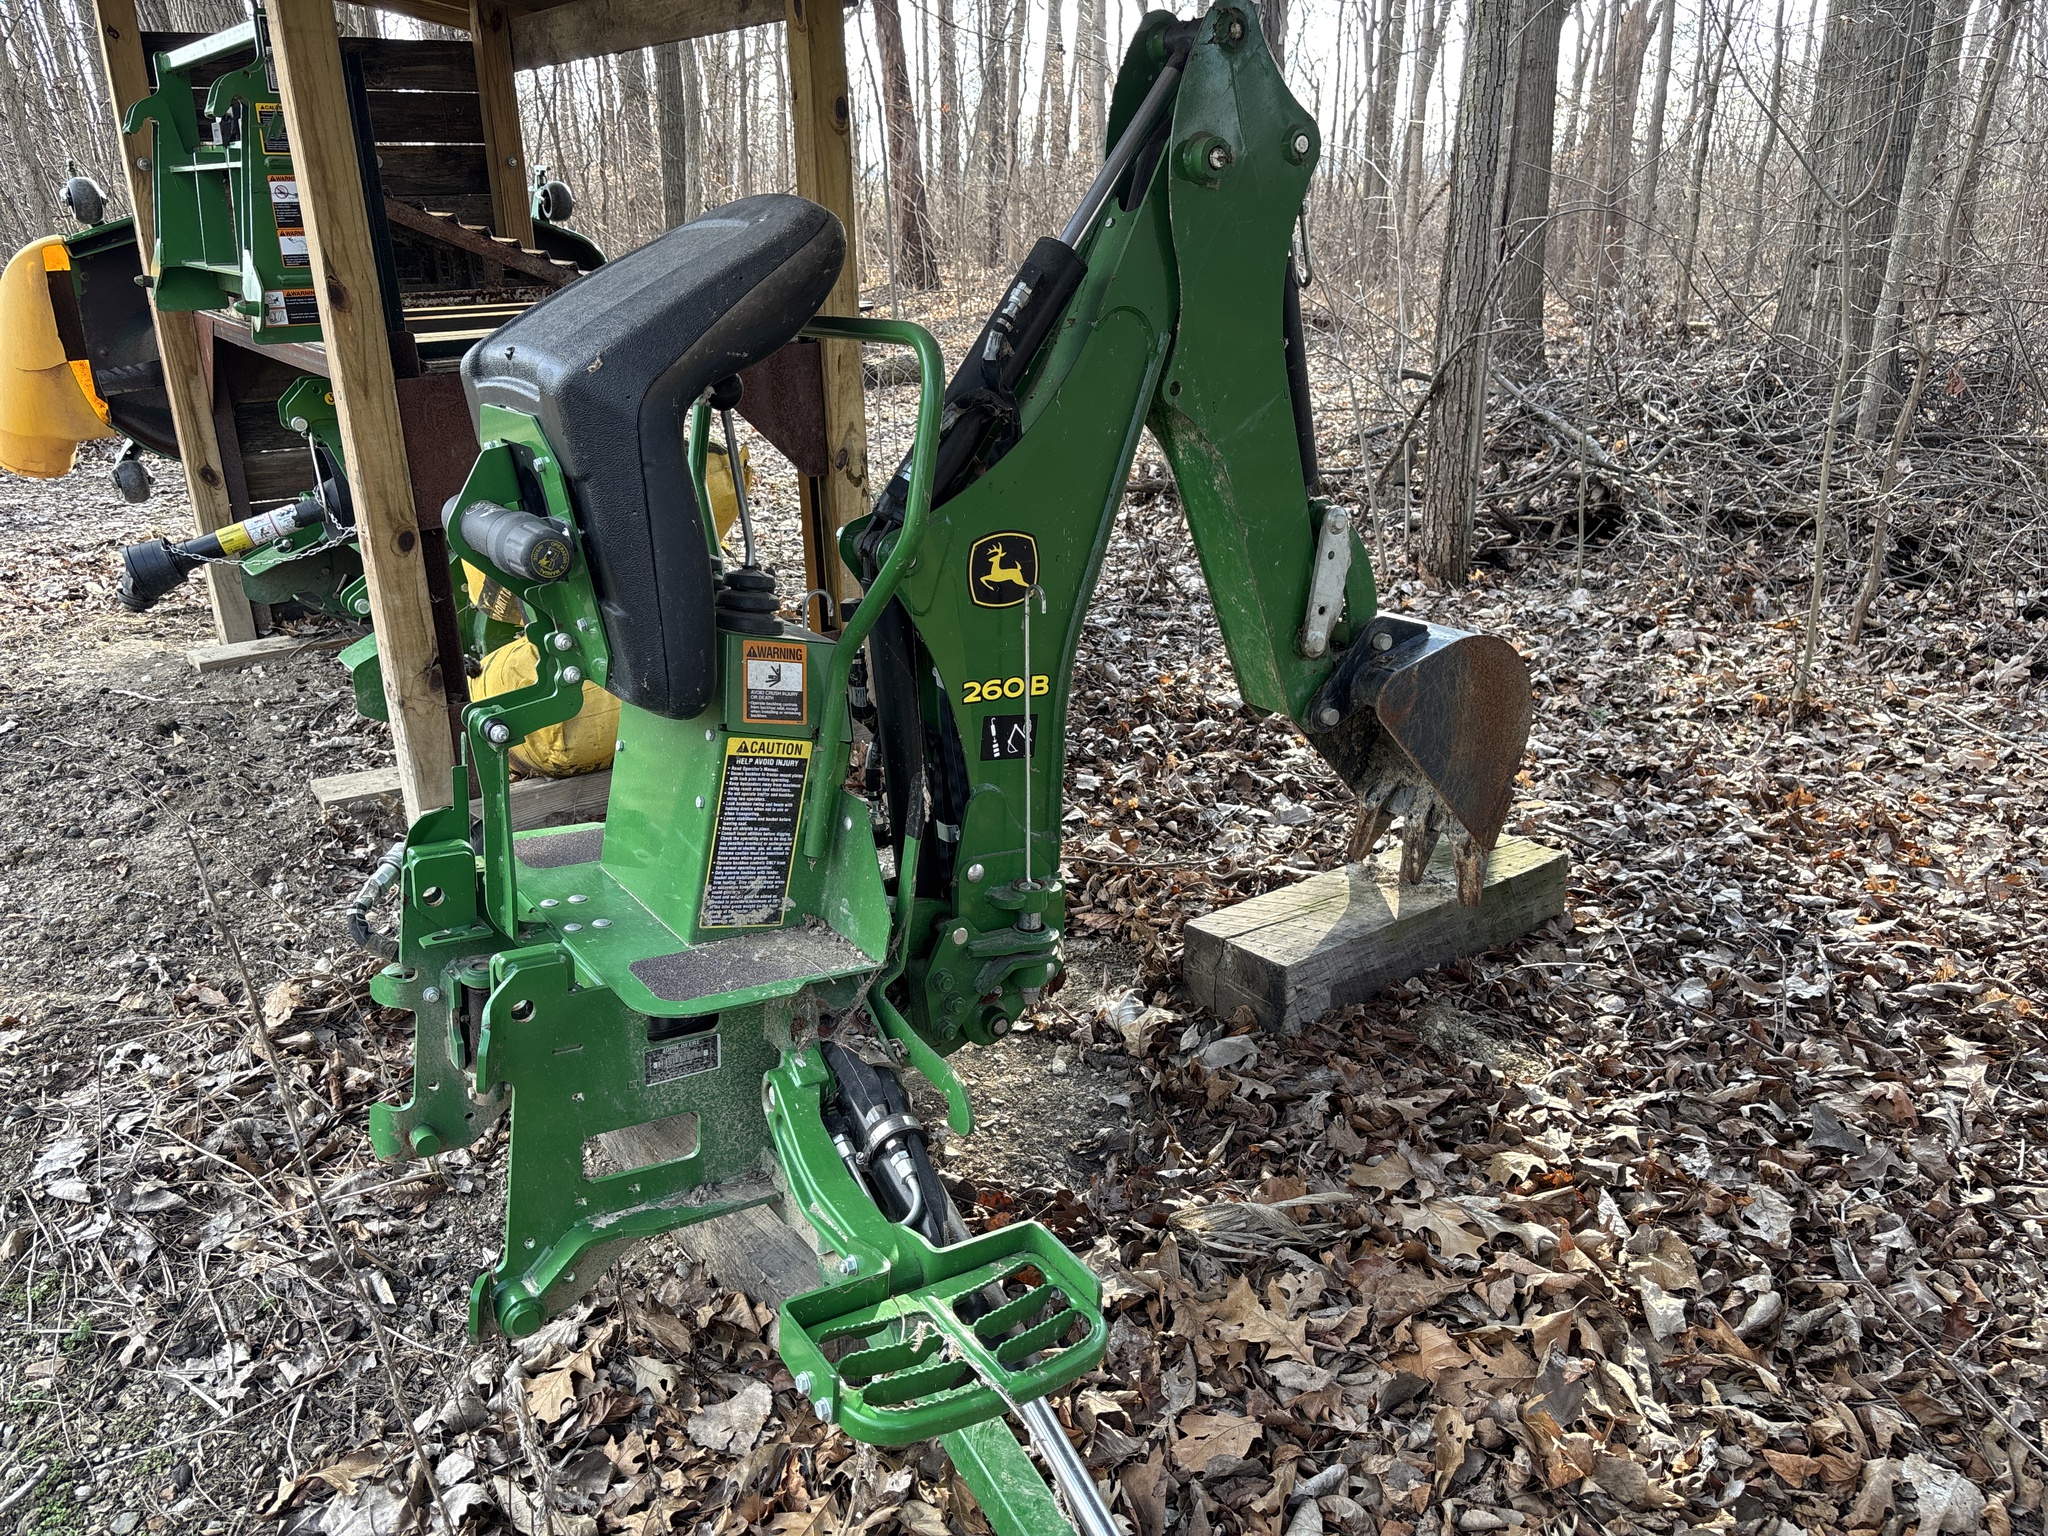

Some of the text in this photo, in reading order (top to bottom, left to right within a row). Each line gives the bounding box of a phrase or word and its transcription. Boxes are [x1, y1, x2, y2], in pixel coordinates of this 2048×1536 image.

[757, 646, 802, 660] WARNING
[962, 674, 1050, 705] 260B
[750, 741, 803, 755] CAUTION
[662, 1040, 699, 1054] JOHN DEERE
